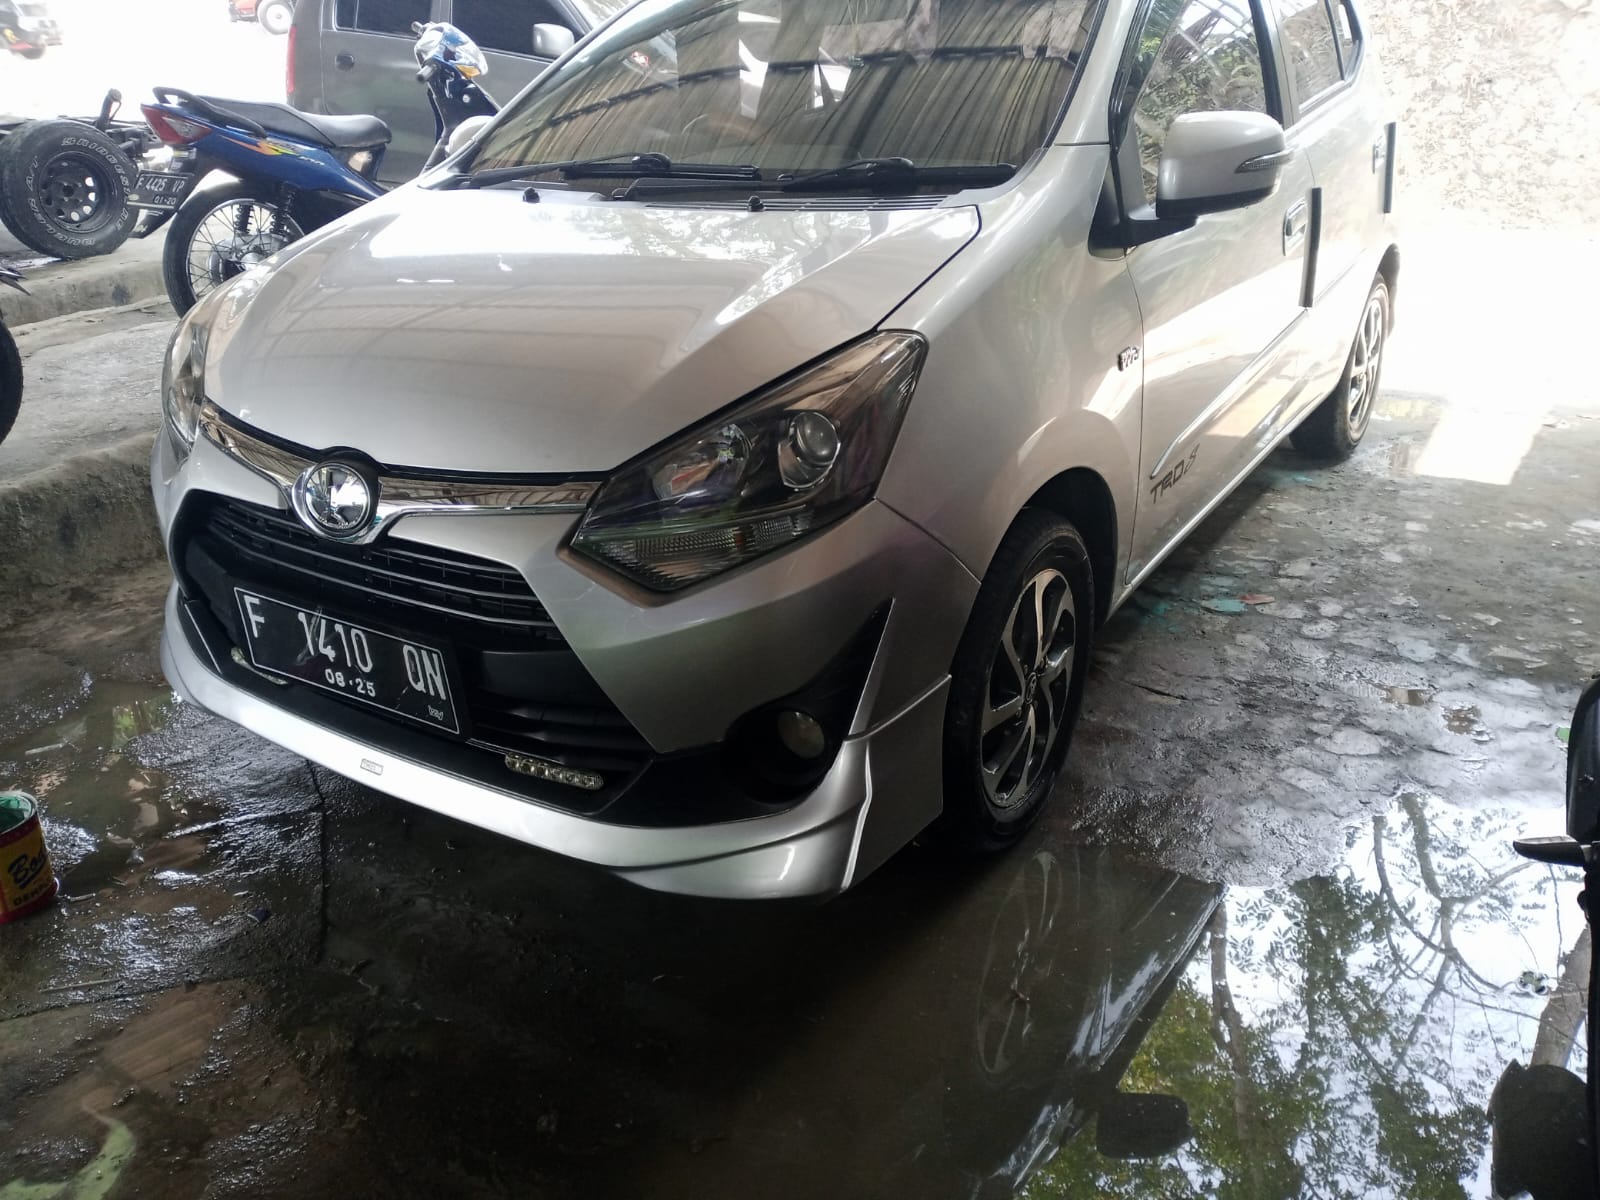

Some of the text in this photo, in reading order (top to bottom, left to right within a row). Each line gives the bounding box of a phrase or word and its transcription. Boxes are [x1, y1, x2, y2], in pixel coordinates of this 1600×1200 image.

[135, 177, 145, 190] F
[145, 177, 168, 192] 4425
[244, 594, 446, 700] F 1410 QN
